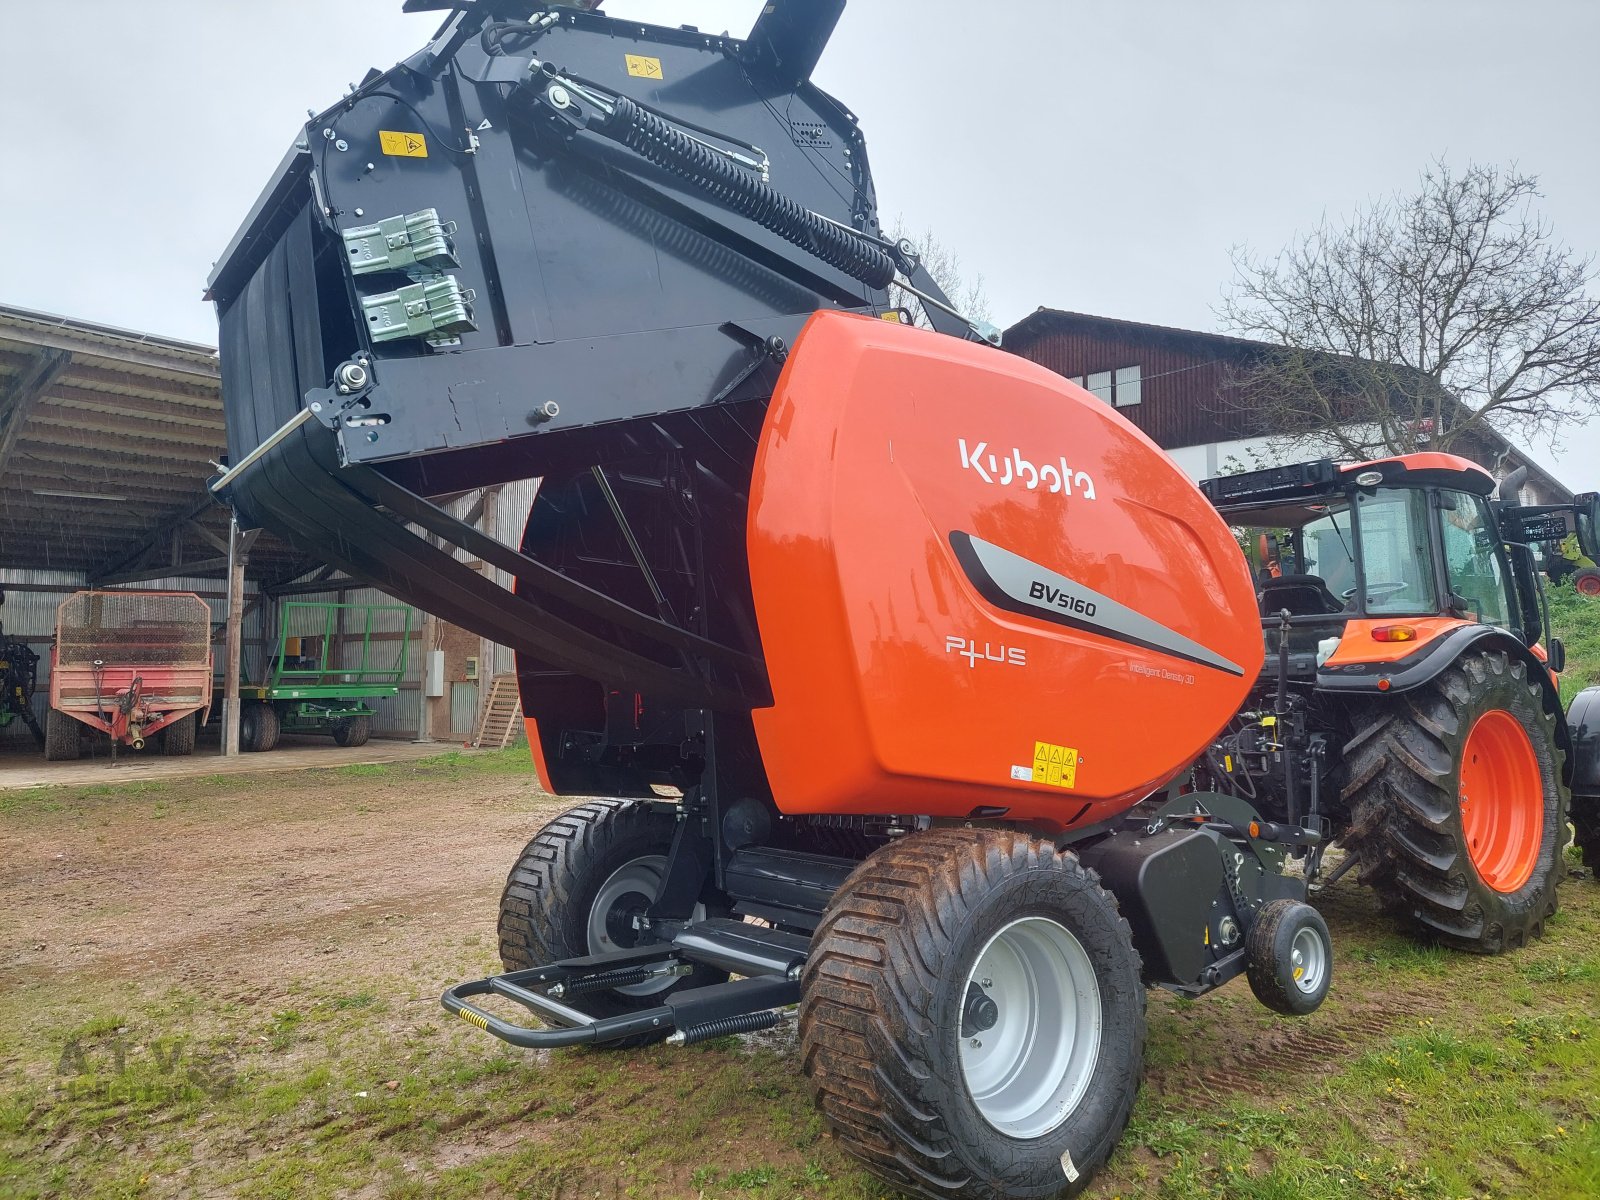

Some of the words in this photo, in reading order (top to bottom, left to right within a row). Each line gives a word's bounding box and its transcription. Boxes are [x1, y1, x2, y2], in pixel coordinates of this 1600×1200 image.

[958, 438, 1096, 500] Kubota
[1029, 580, 1097, 617] BV5160
[1129, 661, 1161, 678] Intelligent
[1161, 668, 1185, 685] Density
[1185, 674, 1195, 685] 3D
